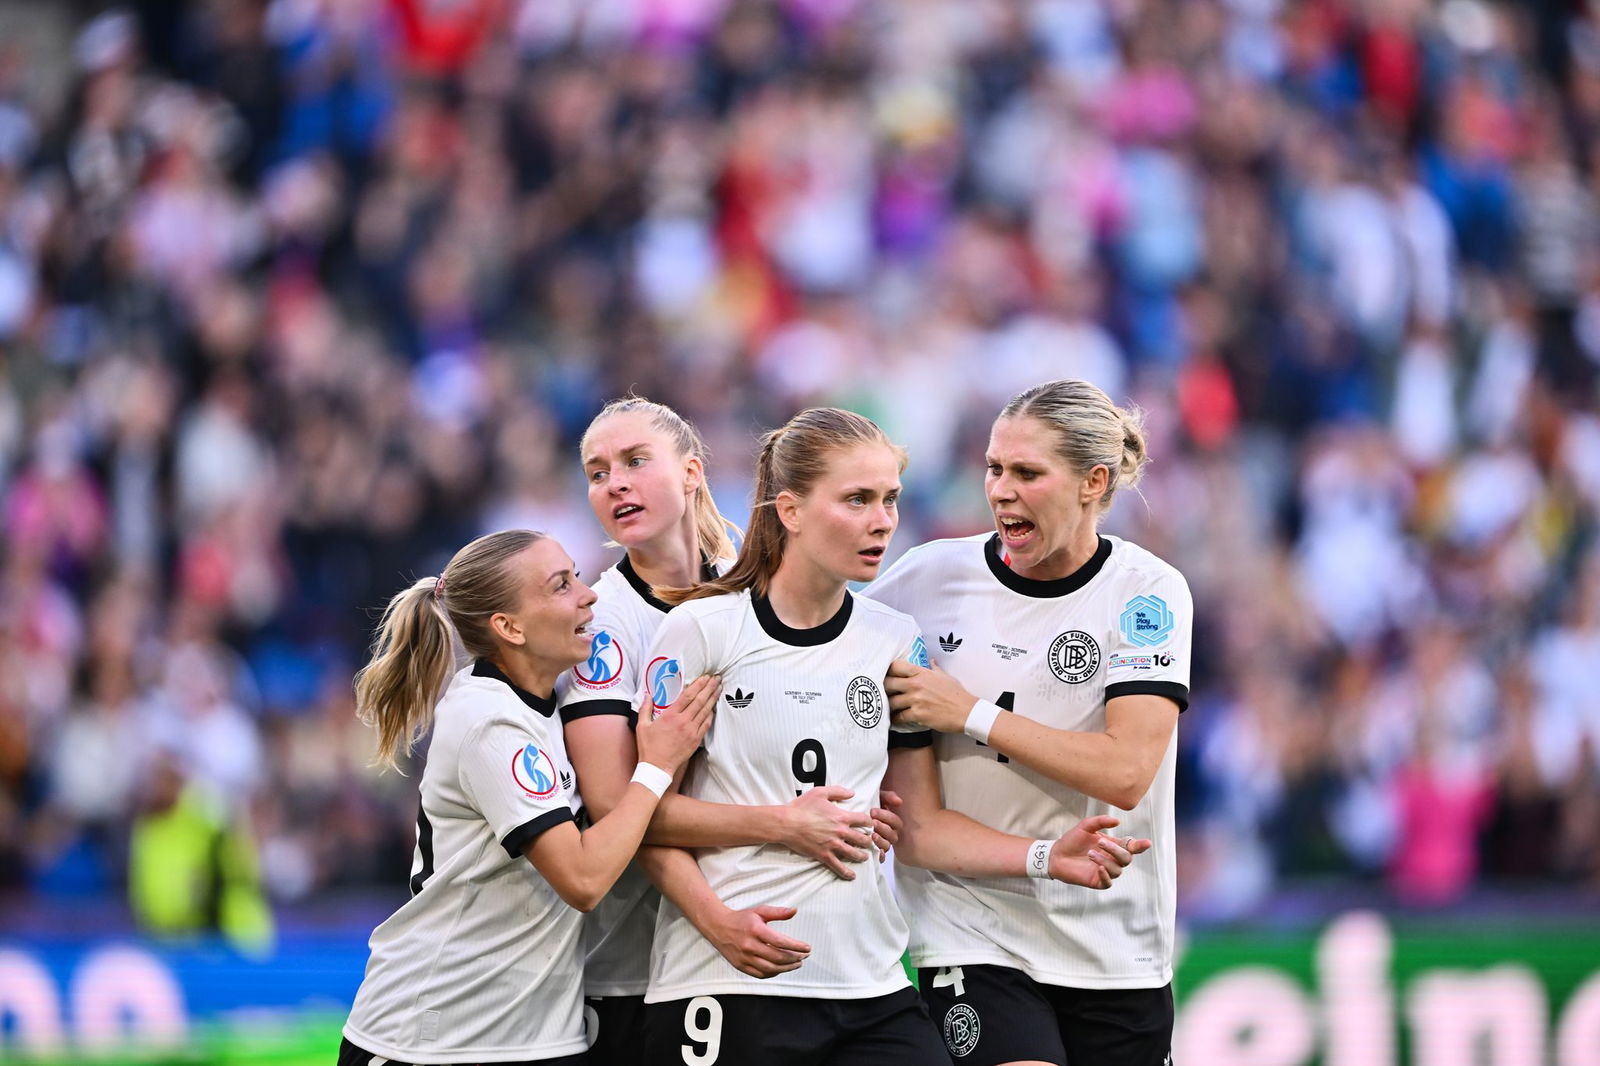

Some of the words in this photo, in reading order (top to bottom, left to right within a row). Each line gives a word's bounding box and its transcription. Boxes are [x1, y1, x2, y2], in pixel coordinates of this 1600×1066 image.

[1051, 635, 1068, 676] DEUTSCHER
[1108, 657, 1151, 666] FOUNDATION
[575, 678, 610, 691] SWITZERLAND
[848, 680, 859, 720] DEUTSCHER
[792, 738, 827, 797] 9
[681, 995, 723, 1066] 9
